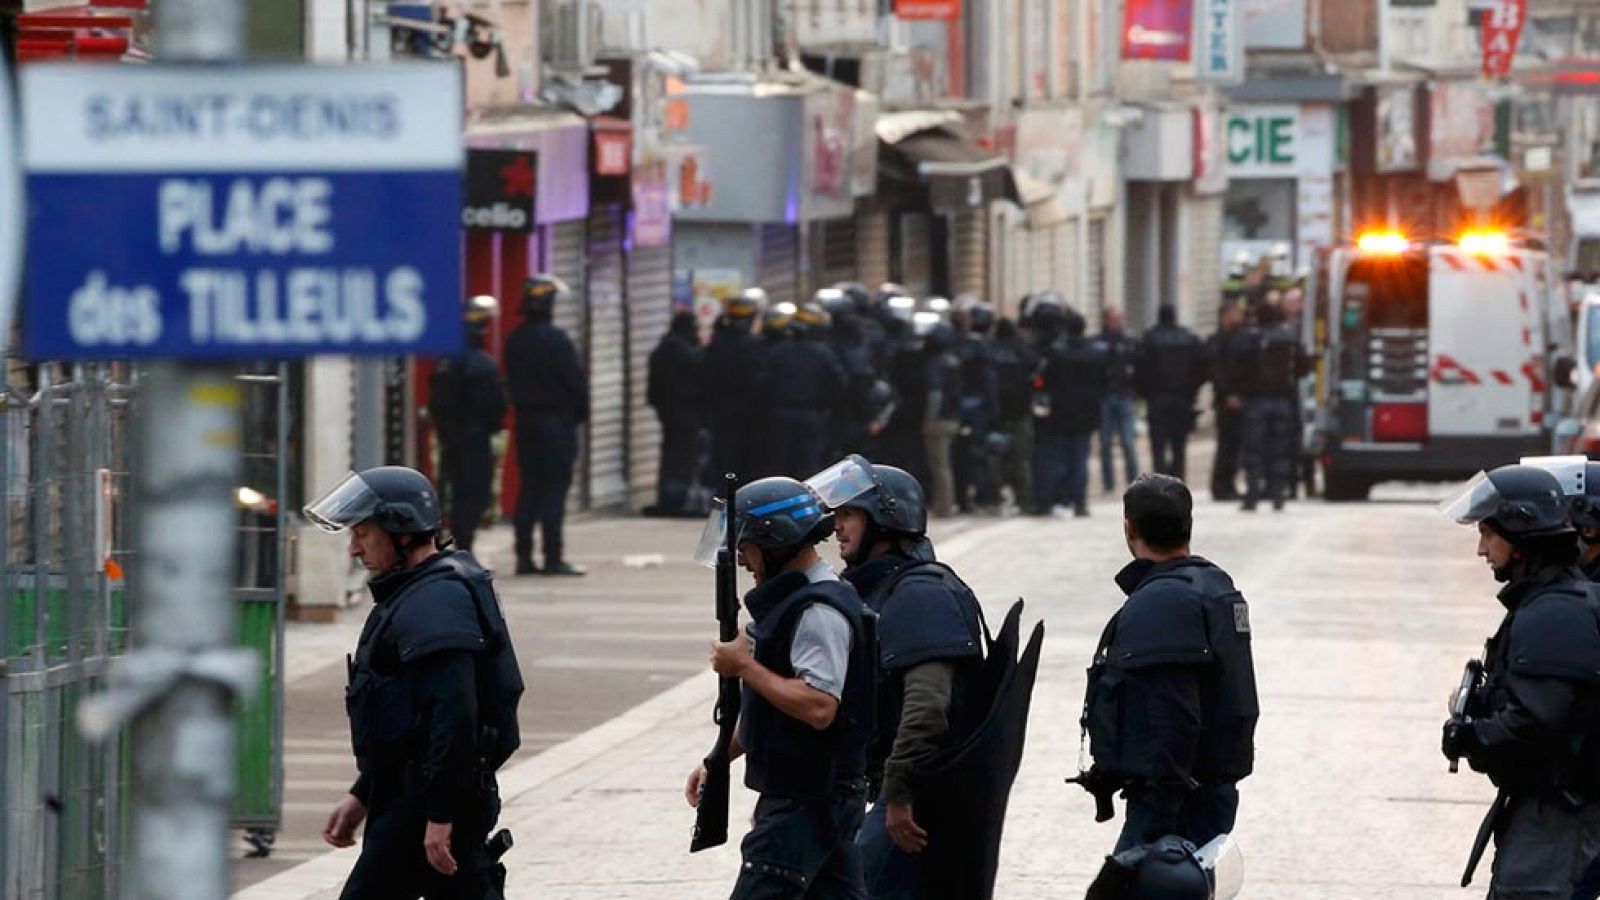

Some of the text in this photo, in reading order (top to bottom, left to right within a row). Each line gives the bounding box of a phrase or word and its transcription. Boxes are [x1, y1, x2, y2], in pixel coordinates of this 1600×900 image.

[84, 91, 399, 143] SAINT-DENIS
[1227, 115, 1295, 164] CIE
[157, 175, 334, 255] PLACE
[462, 202, 527, 229] celio
[67, 266, 426, 346] des TILLEULS
